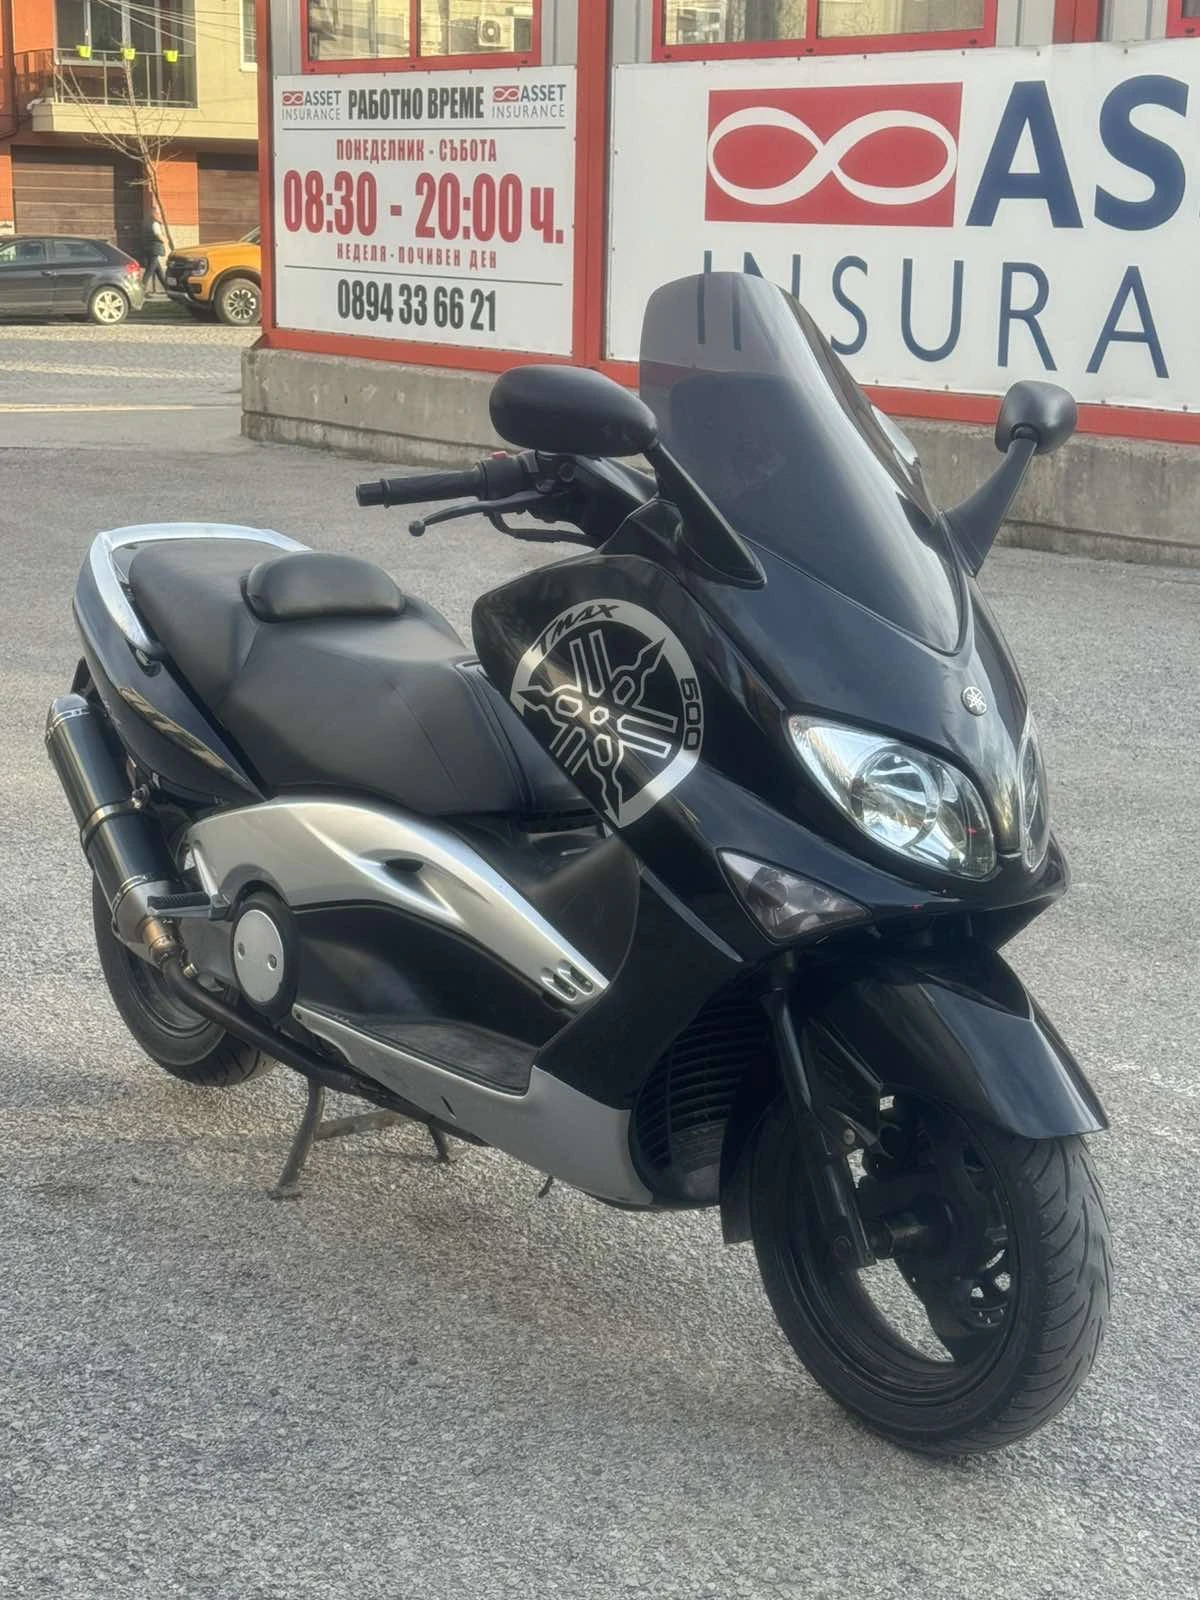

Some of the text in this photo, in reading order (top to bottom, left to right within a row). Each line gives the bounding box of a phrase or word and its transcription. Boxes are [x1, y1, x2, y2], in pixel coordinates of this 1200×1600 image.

[304, 90, 342, 105] ASSET
[348, 86, 485, 120] РАБОТНО ВРЕМЕ
[520, 84, 567, 103] ASSET
[282, 108, 341, 120] INSURANCE
[492, 104, 565, 119] INSURANCE
[336, 139, 425, 164] ПОНЕДЕЛНИК
[439, 139, 497, 162] СЪБОТА
[966, 74, 1200, 232] AS
[283, 169, 378, 236] 08:30
[390, 204, 403, 217] -
[415, 172, 523, 243] 20:00
[337, 243, 387, 263] НЕДЕЛЯ
[398, 246, 461, 267] ПОЧИВЕН
[469, 250, 497, 271] ДЕН
[337, 278, 496, 331] 0894 33 66 21
[680, 677, 700, 751] 500
